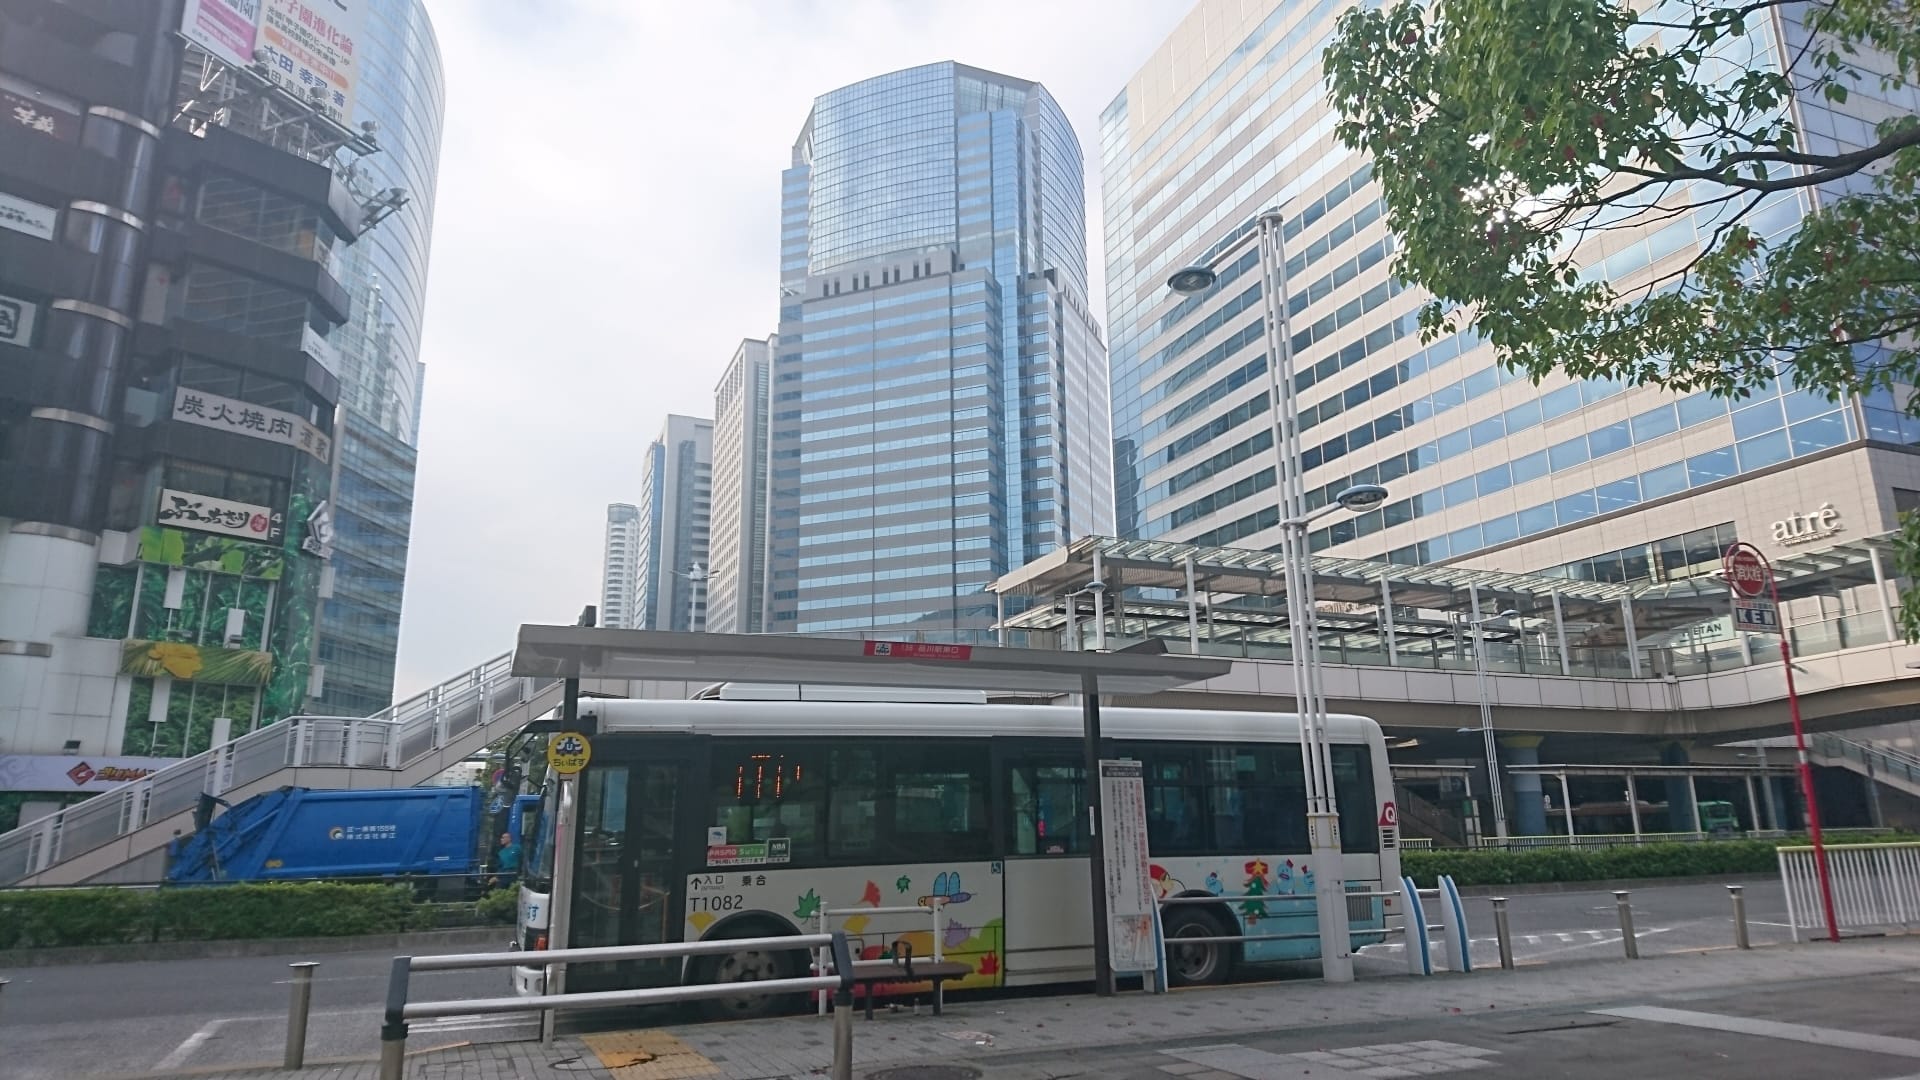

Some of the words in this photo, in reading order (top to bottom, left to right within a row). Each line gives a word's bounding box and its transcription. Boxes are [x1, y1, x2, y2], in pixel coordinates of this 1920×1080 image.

[272, 0, 353, 56] 子園進化論
[1770, 502, 1838, 541] atré
[1735, 564, 1762, 581] 消火栓
[1738, 608, 1774, 625] KEN
[709, 848, 737, 858] PASMO
[704, 875, 724, 885] 入口
[742, 875, 766, 886] 乗合
[689, 894, 743, 912] T1082
